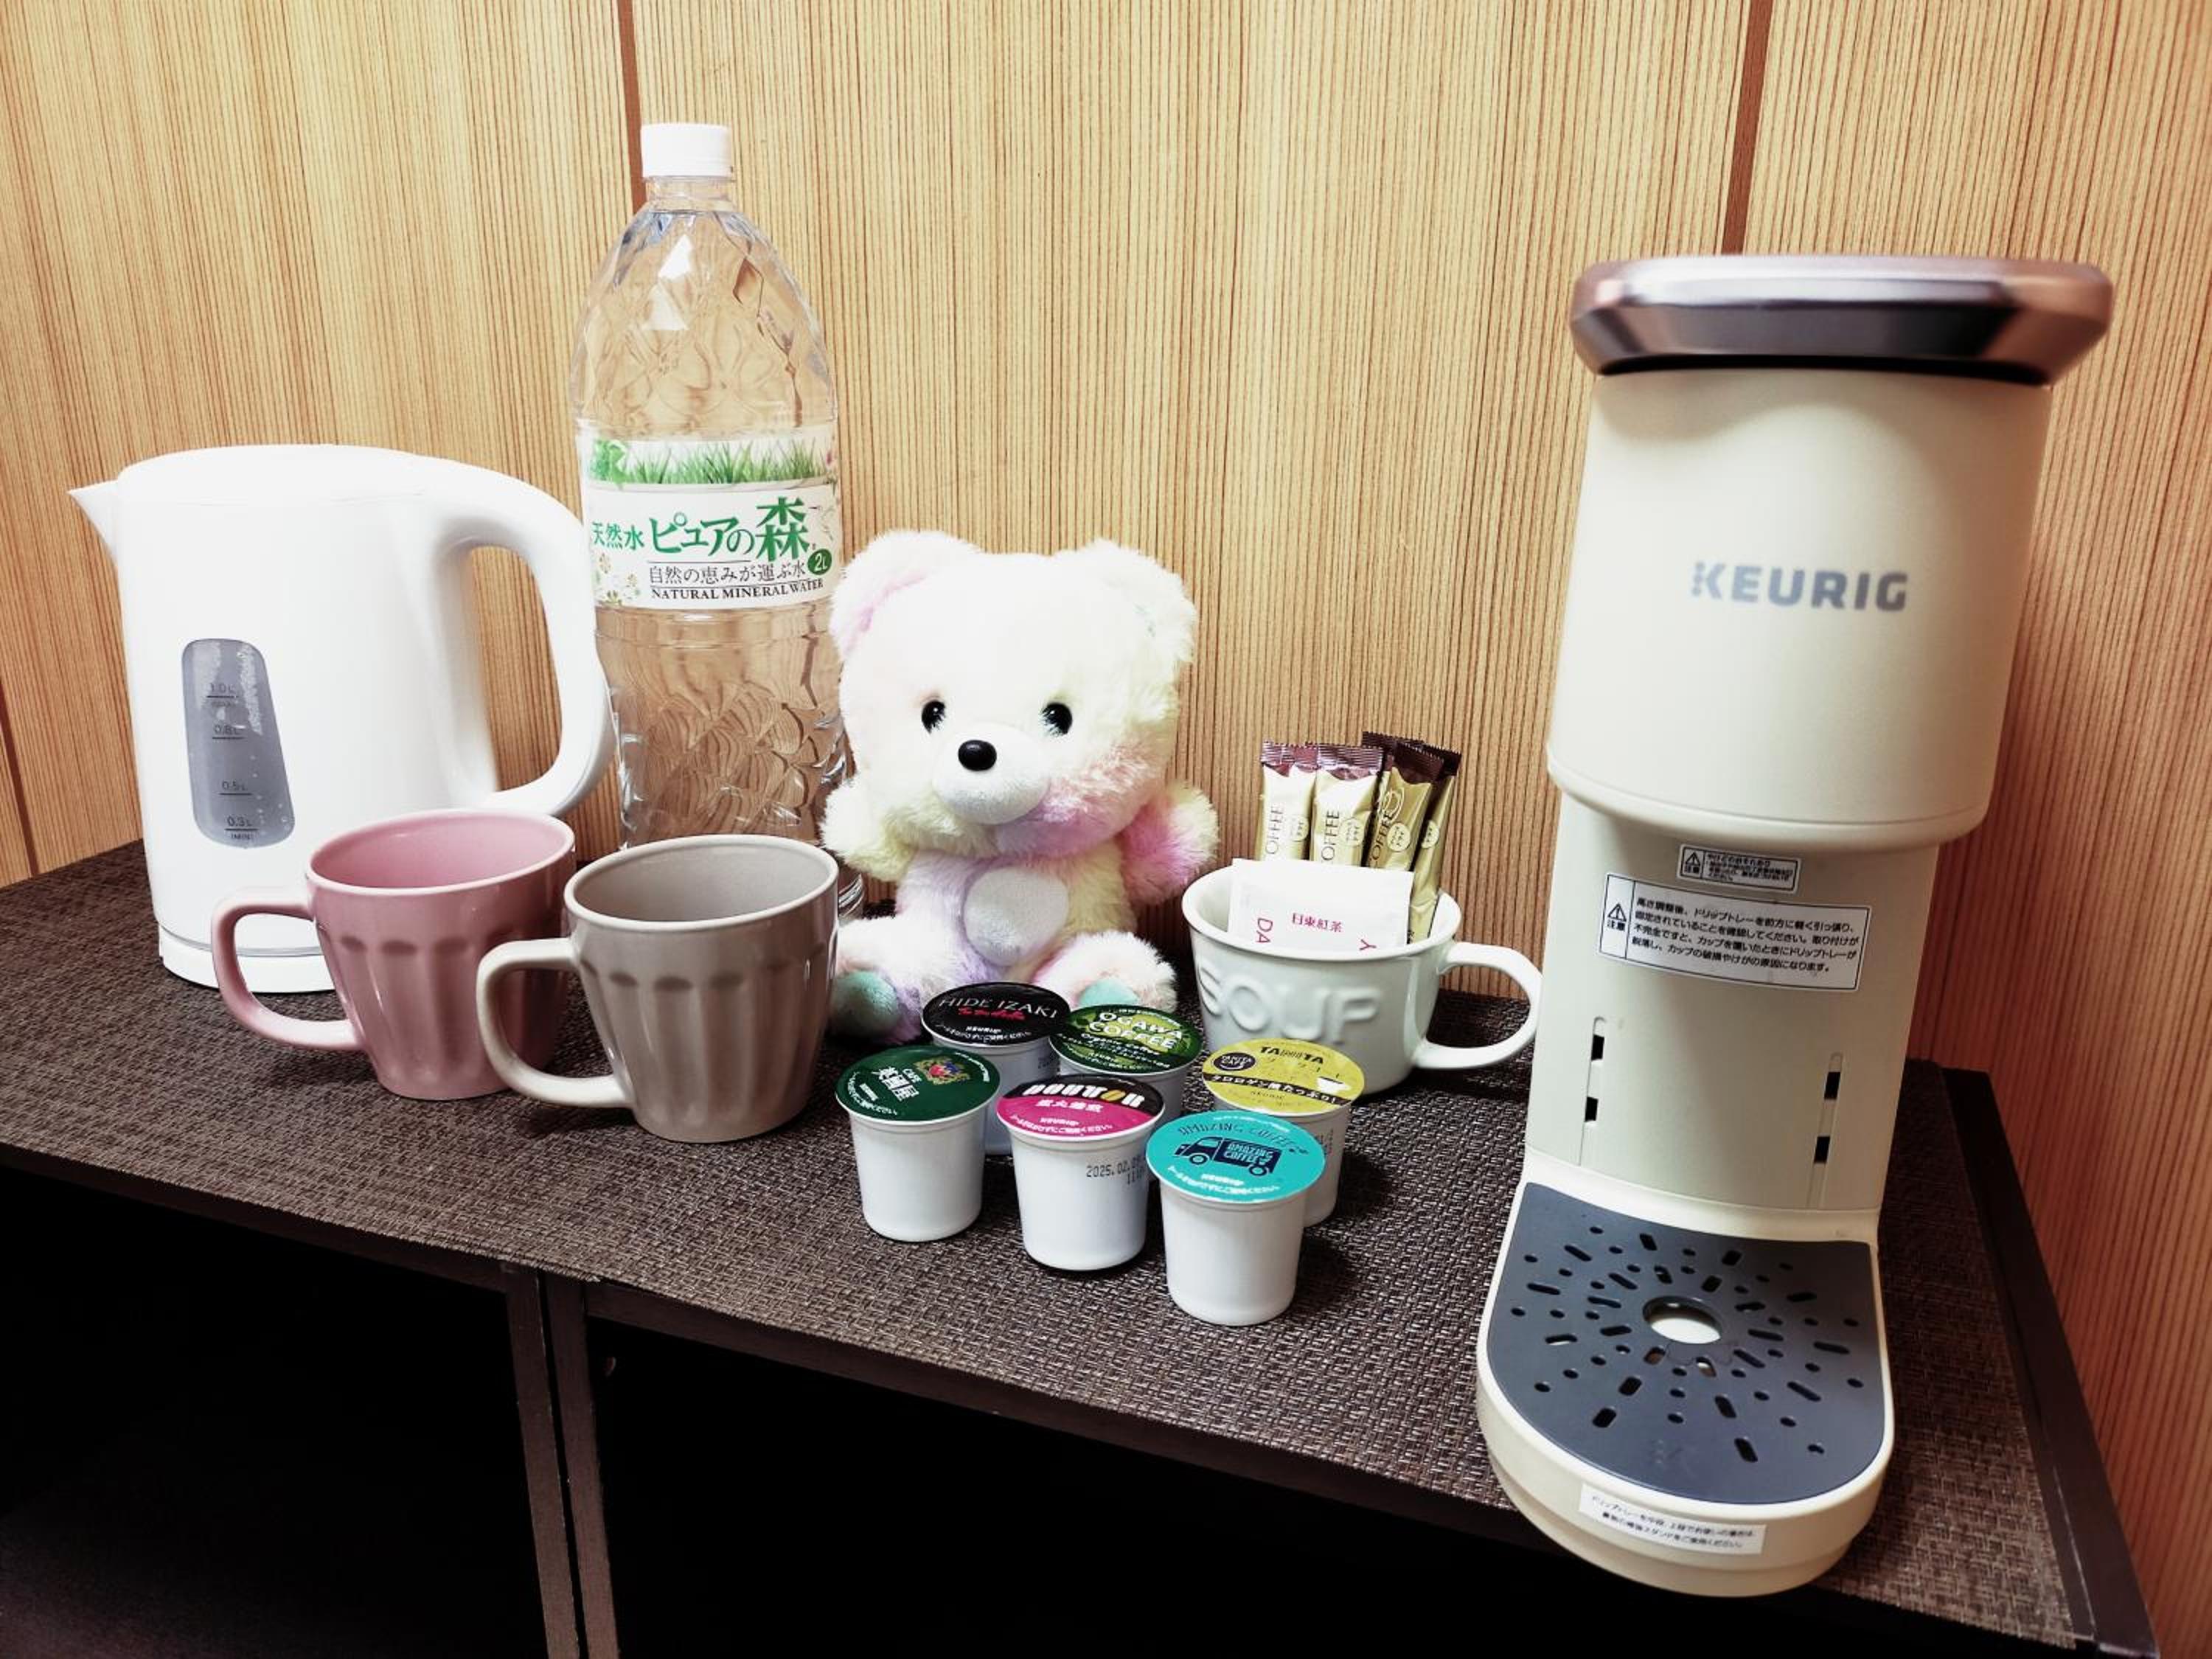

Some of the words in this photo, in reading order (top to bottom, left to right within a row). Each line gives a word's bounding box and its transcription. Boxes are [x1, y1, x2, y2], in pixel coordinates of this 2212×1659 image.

[592, 521, 645, 551] 天然水
[649, 496, 810, 562] ピュアの森
[649, 561, 806, 585] 自然の恵みが運ぶ水
[1691, 561, 1908, 612] KEURIG
[650, 587, 720, 601] NATURAL
[722, 585, 788, 599] MINERAL
[789, 579, 824, 596] WATER
[1265, 805, 1284, 855] OFFEE
[1321, 810, 1340, 864] OFFEE
[1291, 912, 1343, 933] 日東紅茶
[939, 998, 993, 1009] HIDE
[998, 999, 1058, 1019] IZAKI
[1088, 1021, 1178, 1050] COFFEE
